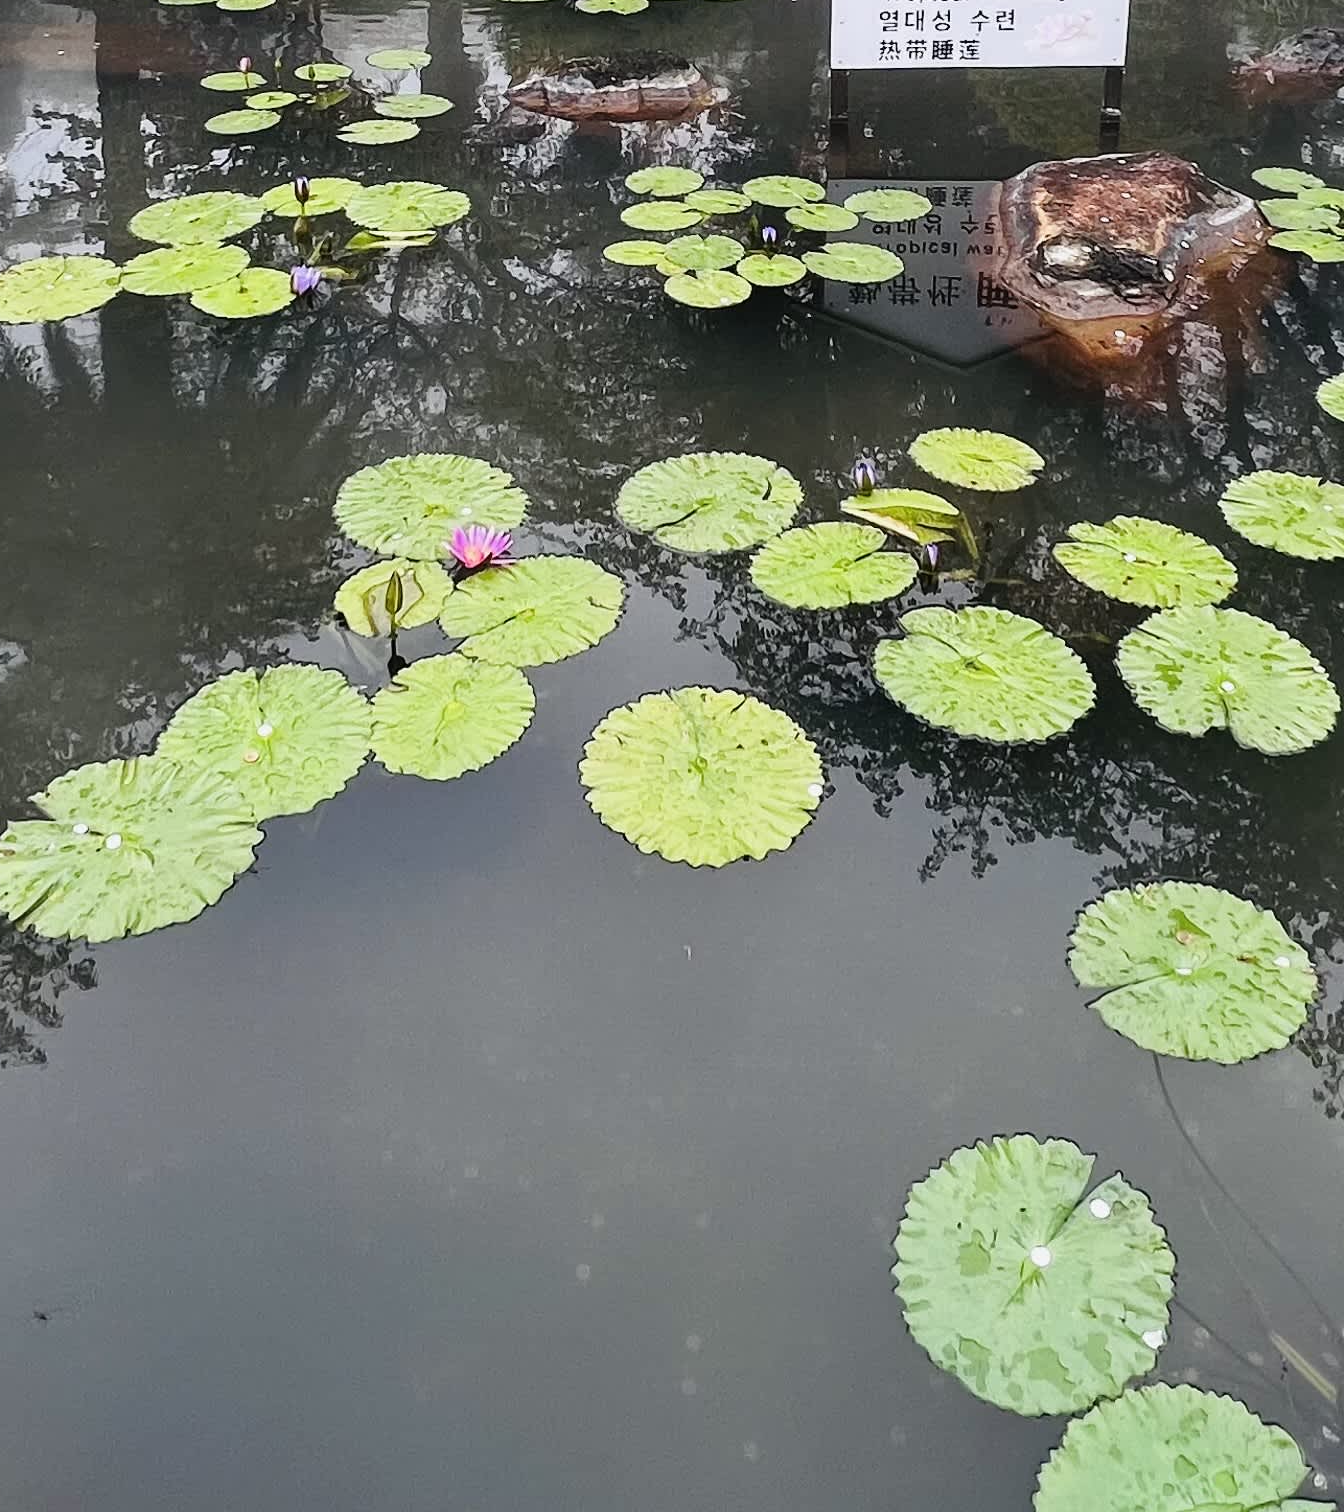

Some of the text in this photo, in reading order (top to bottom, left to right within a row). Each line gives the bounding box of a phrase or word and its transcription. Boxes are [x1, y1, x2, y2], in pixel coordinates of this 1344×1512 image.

[879, 9, 1016, 32] 열대성 수련
[879, 39, 981, 61] 热带睡莲
